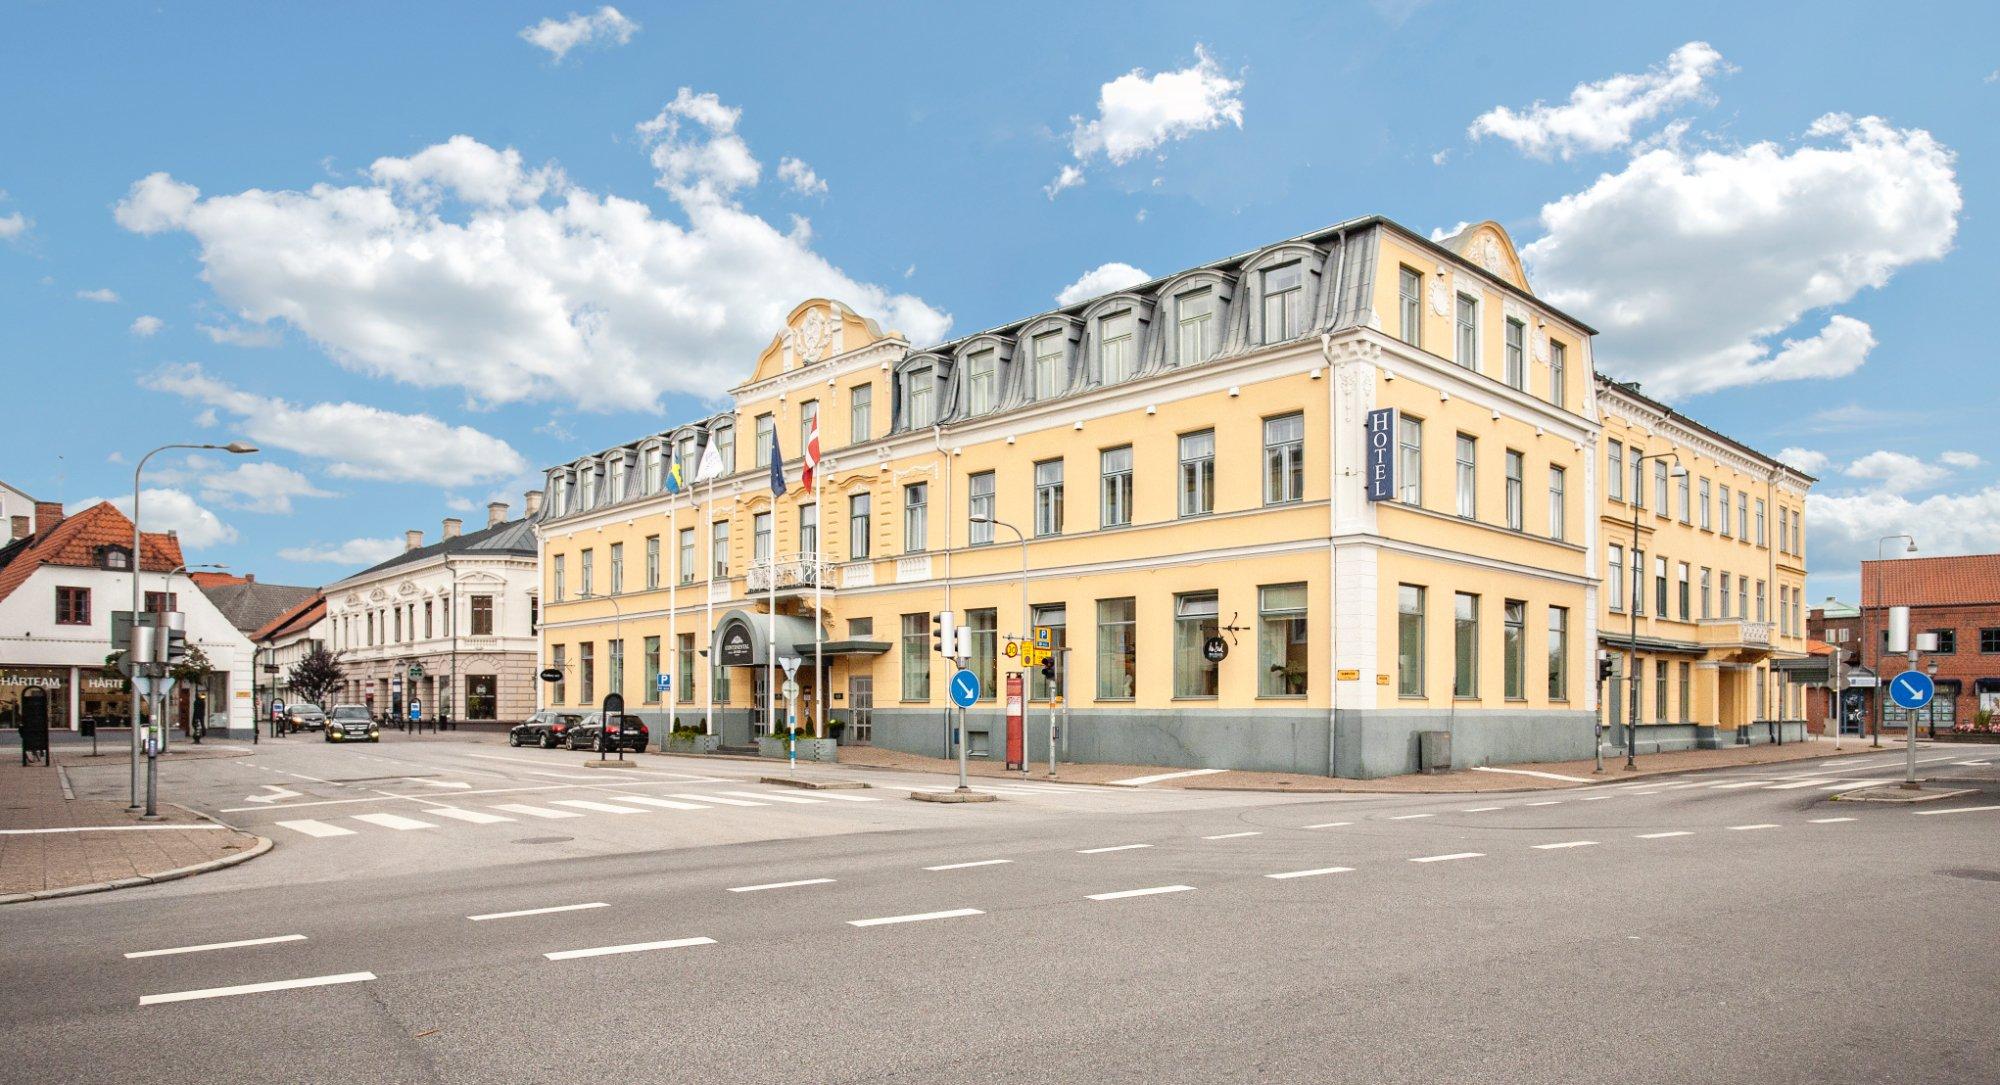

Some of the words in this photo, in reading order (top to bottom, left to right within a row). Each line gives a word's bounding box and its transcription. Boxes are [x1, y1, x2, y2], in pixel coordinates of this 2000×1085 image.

[1372, 411, 1389, 496] HOTEL
[1, 674, 61, 687] HÅRTEAM
[89, 676, 124, 688] HÅRTE
